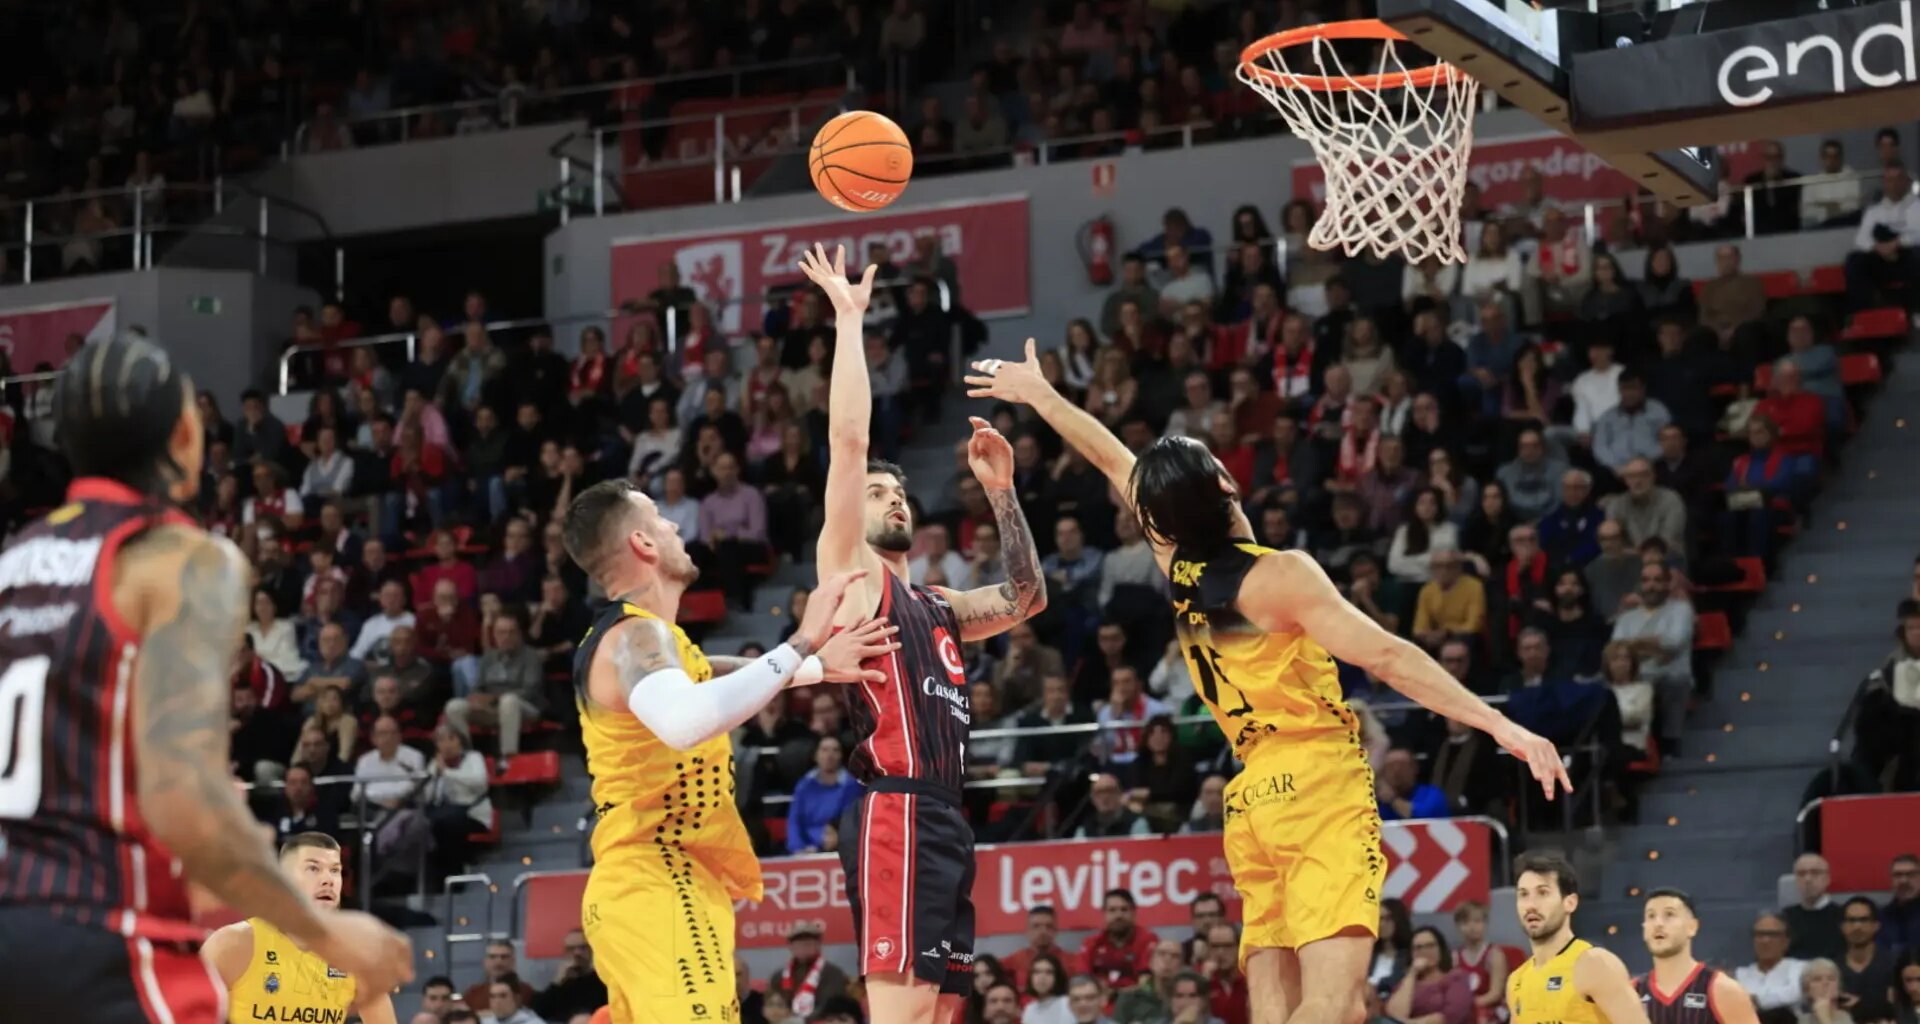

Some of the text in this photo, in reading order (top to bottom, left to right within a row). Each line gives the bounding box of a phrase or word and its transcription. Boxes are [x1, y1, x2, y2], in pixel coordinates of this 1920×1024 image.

[1717, 0, 1917, 108] end
[735, 867, 851, 912] RBE
[1000, 848, 1200, 914] levitec
[252, 1003, 277, 1021] LA
